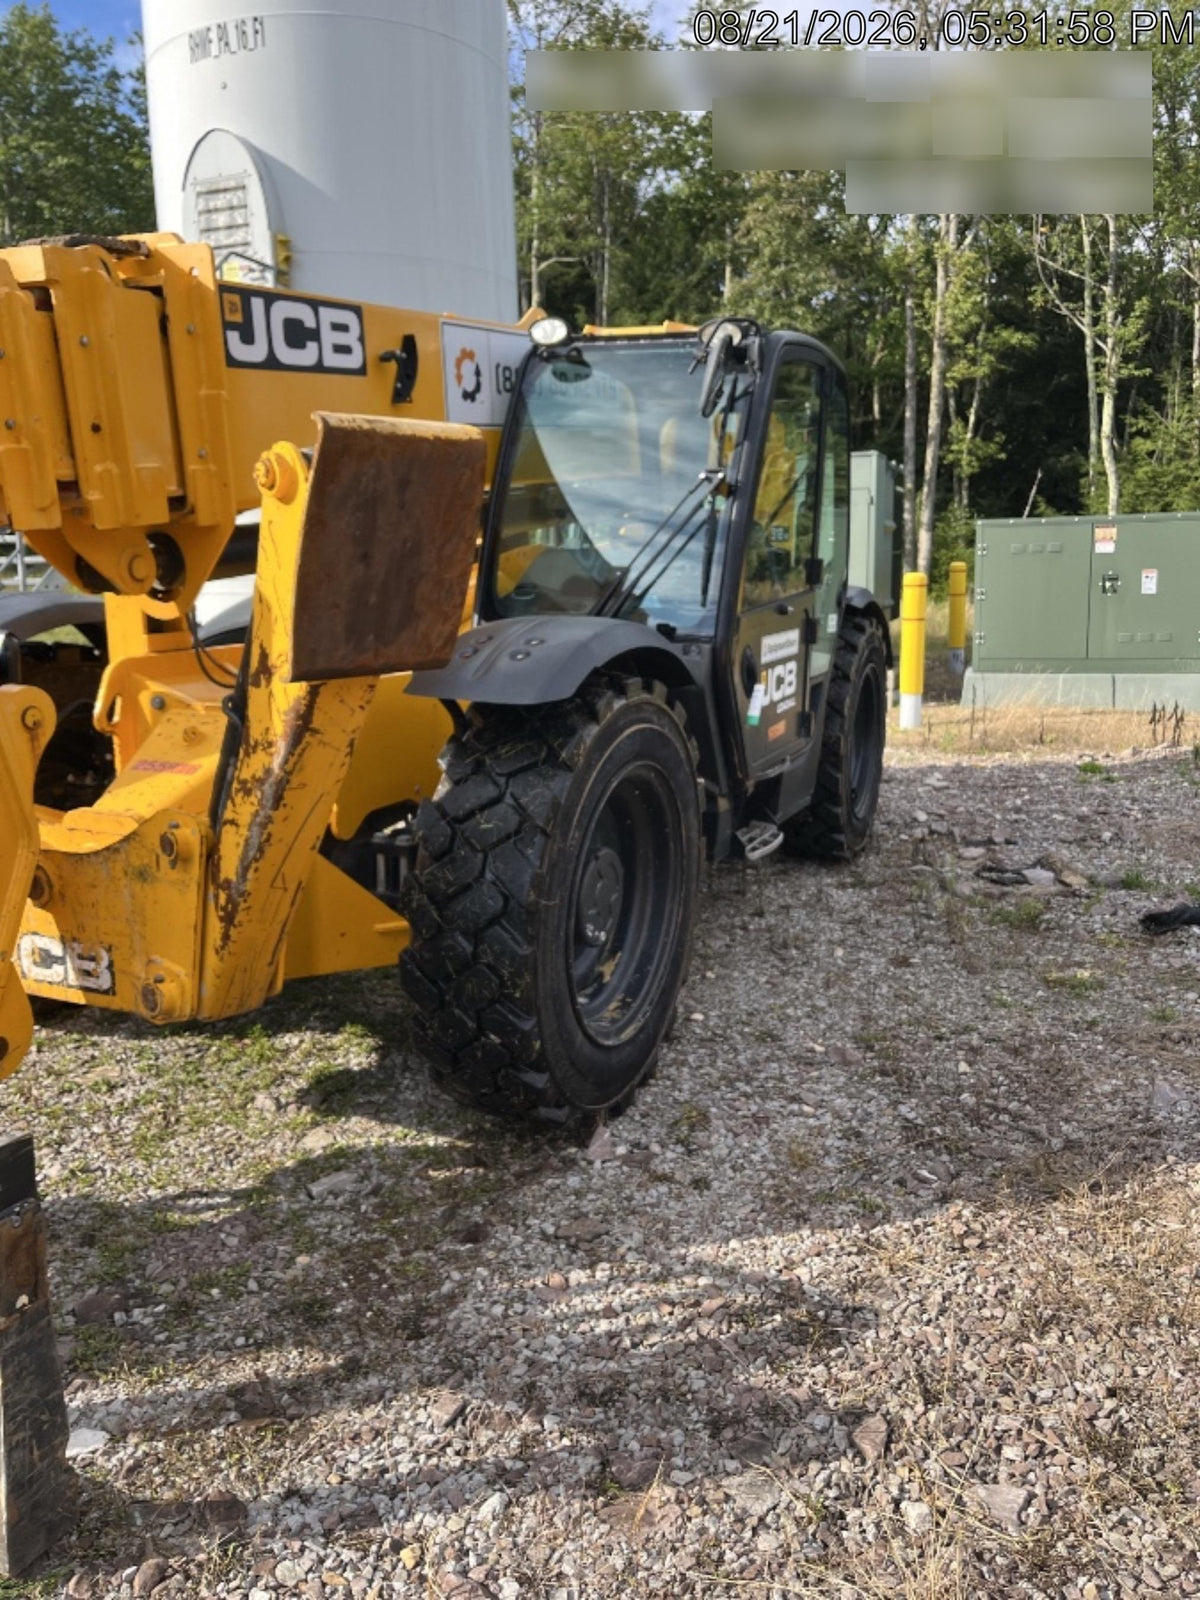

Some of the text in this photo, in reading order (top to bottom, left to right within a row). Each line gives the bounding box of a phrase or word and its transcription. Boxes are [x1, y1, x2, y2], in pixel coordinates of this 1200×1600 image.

[226, 296, 364, 369] JCB
[761, 660, 797, 707] JCB
[19, 933, 112, 992] CB
